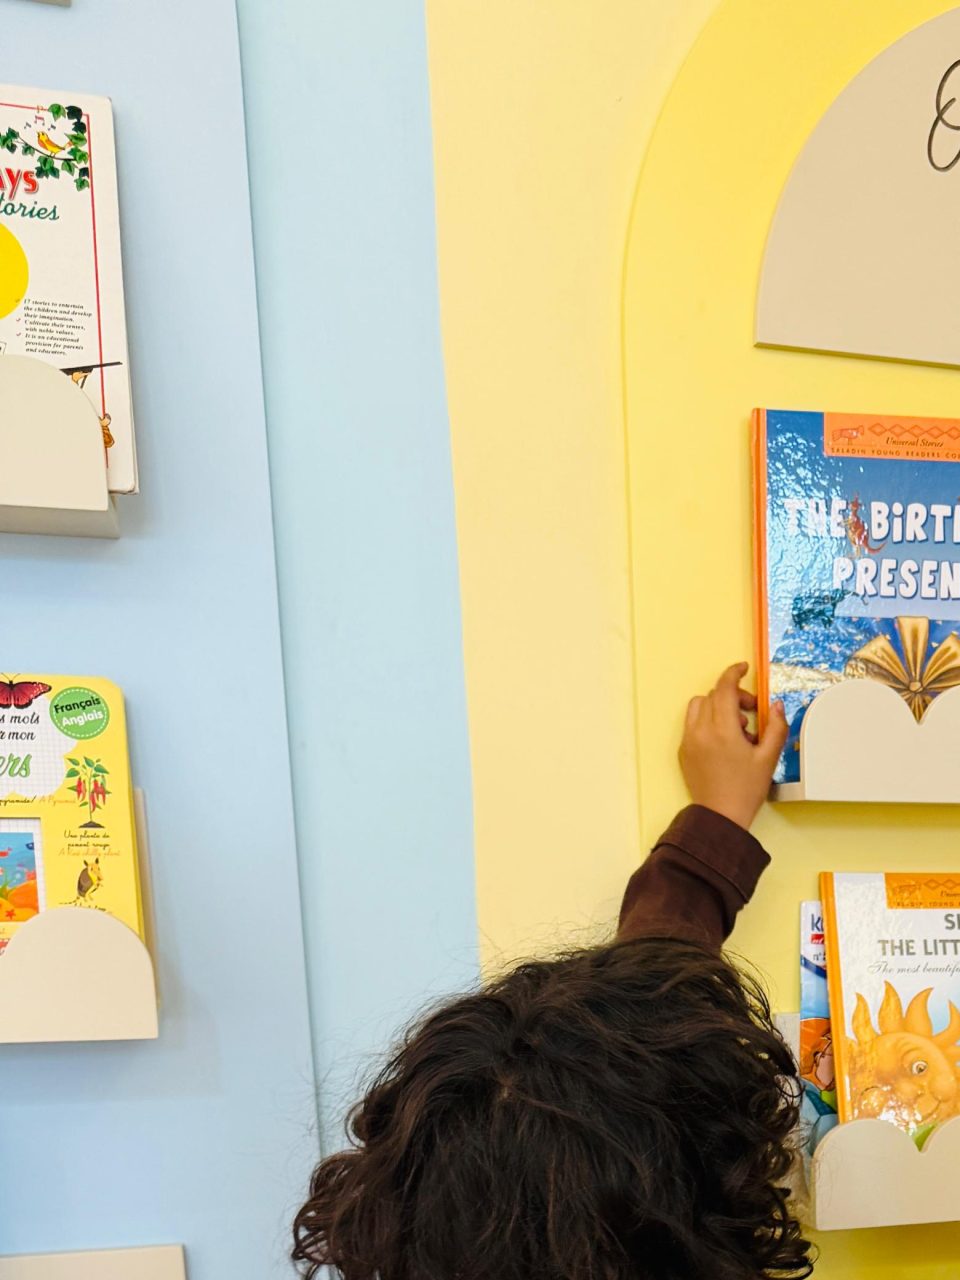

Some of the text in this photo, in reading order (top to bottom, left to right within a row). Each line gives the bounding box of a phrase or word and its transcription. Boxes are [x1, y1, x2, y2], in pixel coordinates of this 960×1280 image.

[871, 449, 900, 457] YOUNG
[906, 451, 941, 459] READERS
[783, 498, 848, 538] THE
[54, 696, 102, 715] Français
[9, 711, 41, 725] mots
[61, 710, 105, 727] Anglais
[8, 731, 36, 741] mon
[877, 939, 917, 956] THE
[867, 960, 894, 975] The
[896, 962, 920, 975] most
